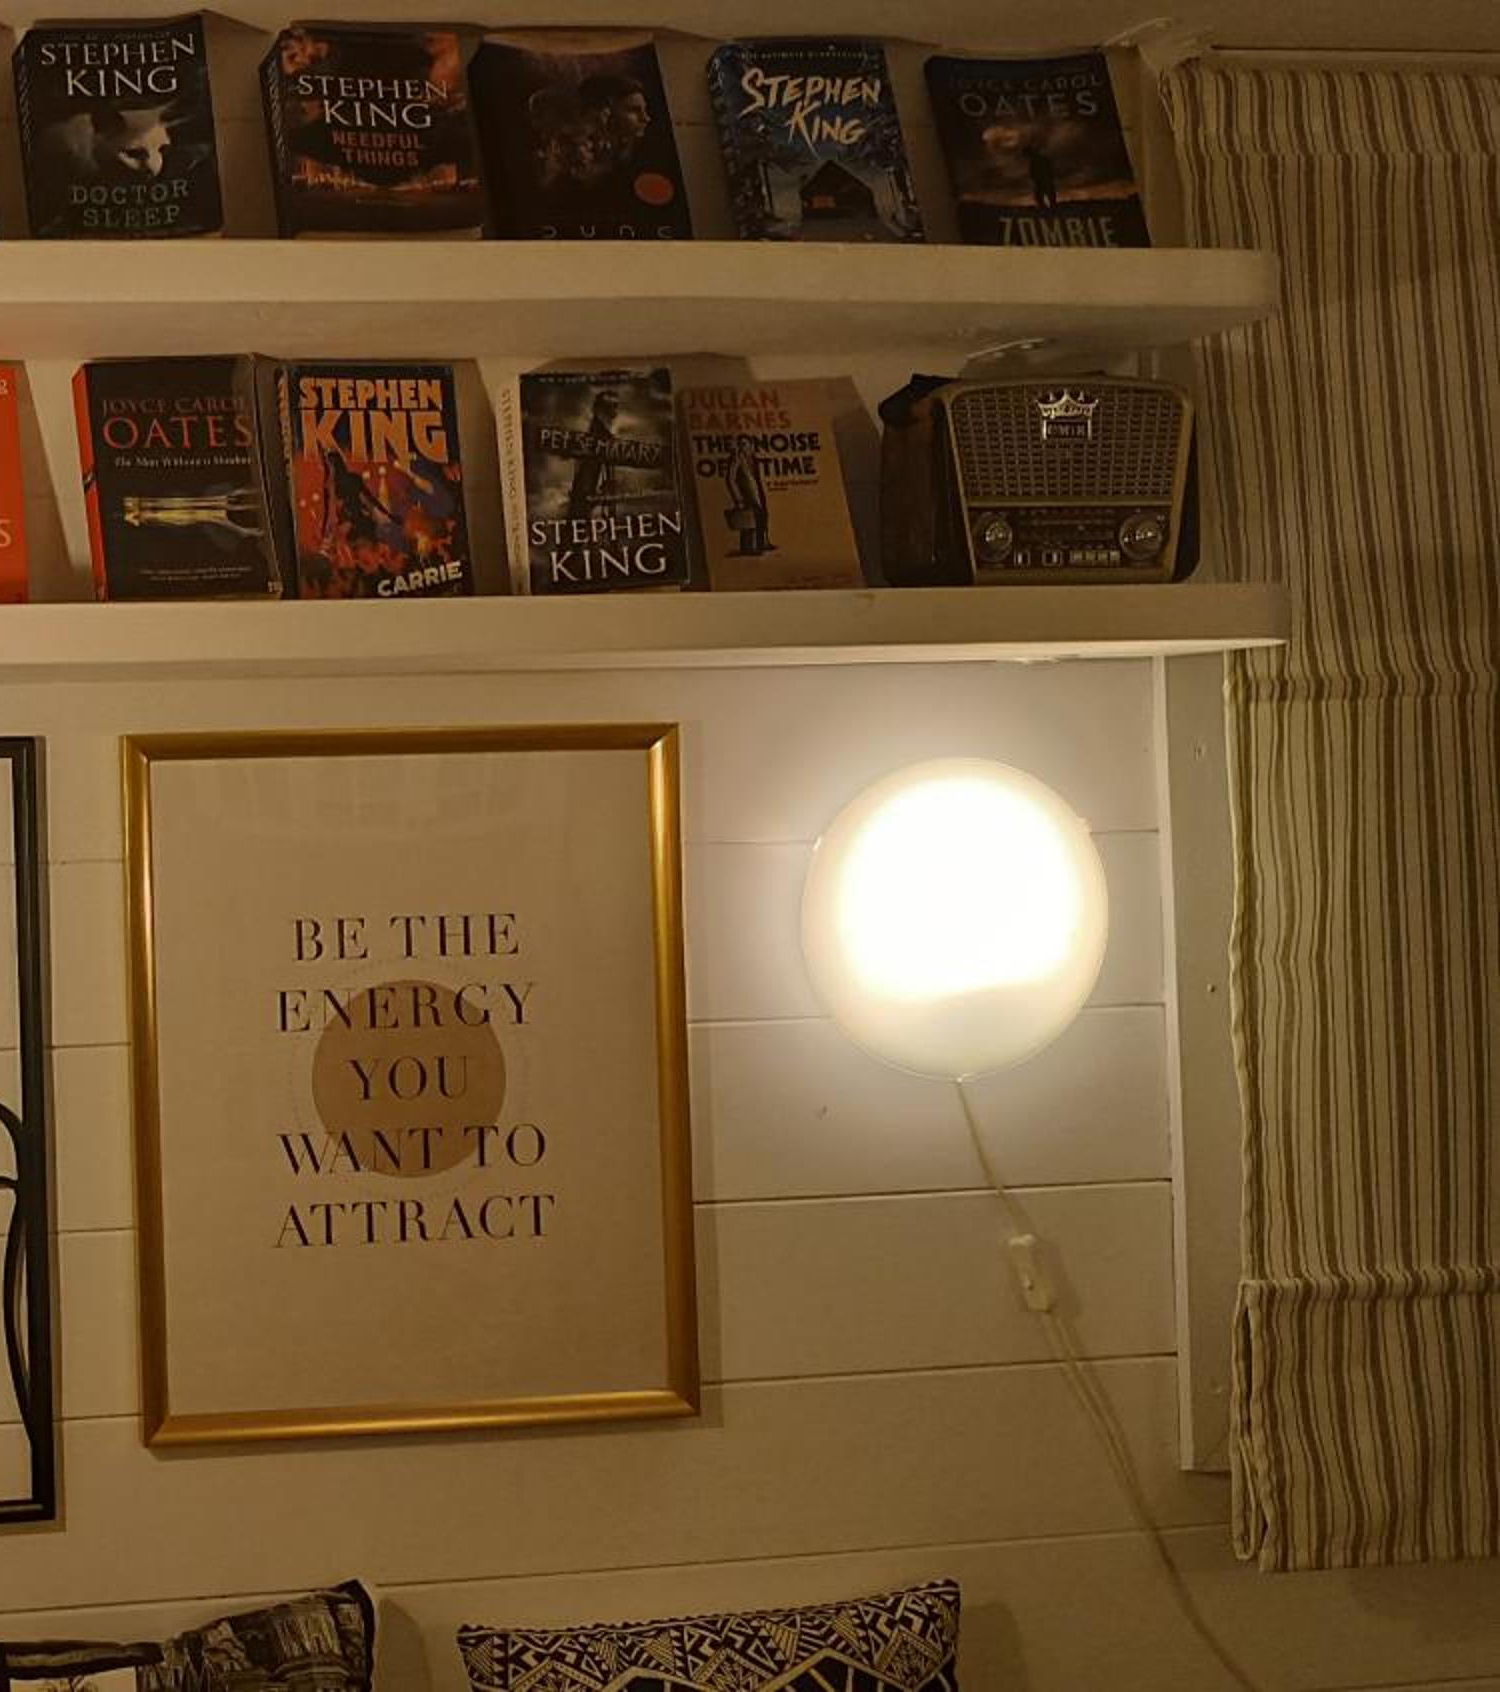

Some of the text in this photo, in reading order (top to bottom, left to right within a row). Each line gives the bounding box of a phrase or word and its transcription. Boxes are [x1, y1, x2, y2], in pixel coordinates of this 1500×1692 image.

[40, 32, 196, 65] STEPHEN
[66, 65, 178, 97] KING
[297, 75, 449, 99] STEPHEN
[740, 67, 881, 120] STEPHEN
[324, 99, 432, 128] KING
[960, 90, 1098, 117] OATES
[331, 129, 423, 149] NEEDFUL
[788, 101, 868, 160] KING
[341, 148, 420, 168] THINGS
[70, 179, 189, 205] DOCTOR
[84, 206, 180, 228] SLEEP
[998, 215, 1119, 246] ZOMBIE
[299, 377, 443, 410] STEPHEN
[103, 416, 253, 449] OATES
[301, 409, 449, 464] KING
[691, 432, 821, 454] THE NOISE
[755, 455, 817, 476] TIME
[531, 511, 682, 546] STEPHEN
[377, 560, 463, 597] CARRIE
[549, 543, 667, 583] KING
[292, 913, 520, 962] BE THE
[275, 982, 538, 1033] ENERGY
[348, 1054, 469, 1102] YOU
[275, 1122, 547, 1176] WANT TO
[271, 1193, 556, 1249] ATTRACT
